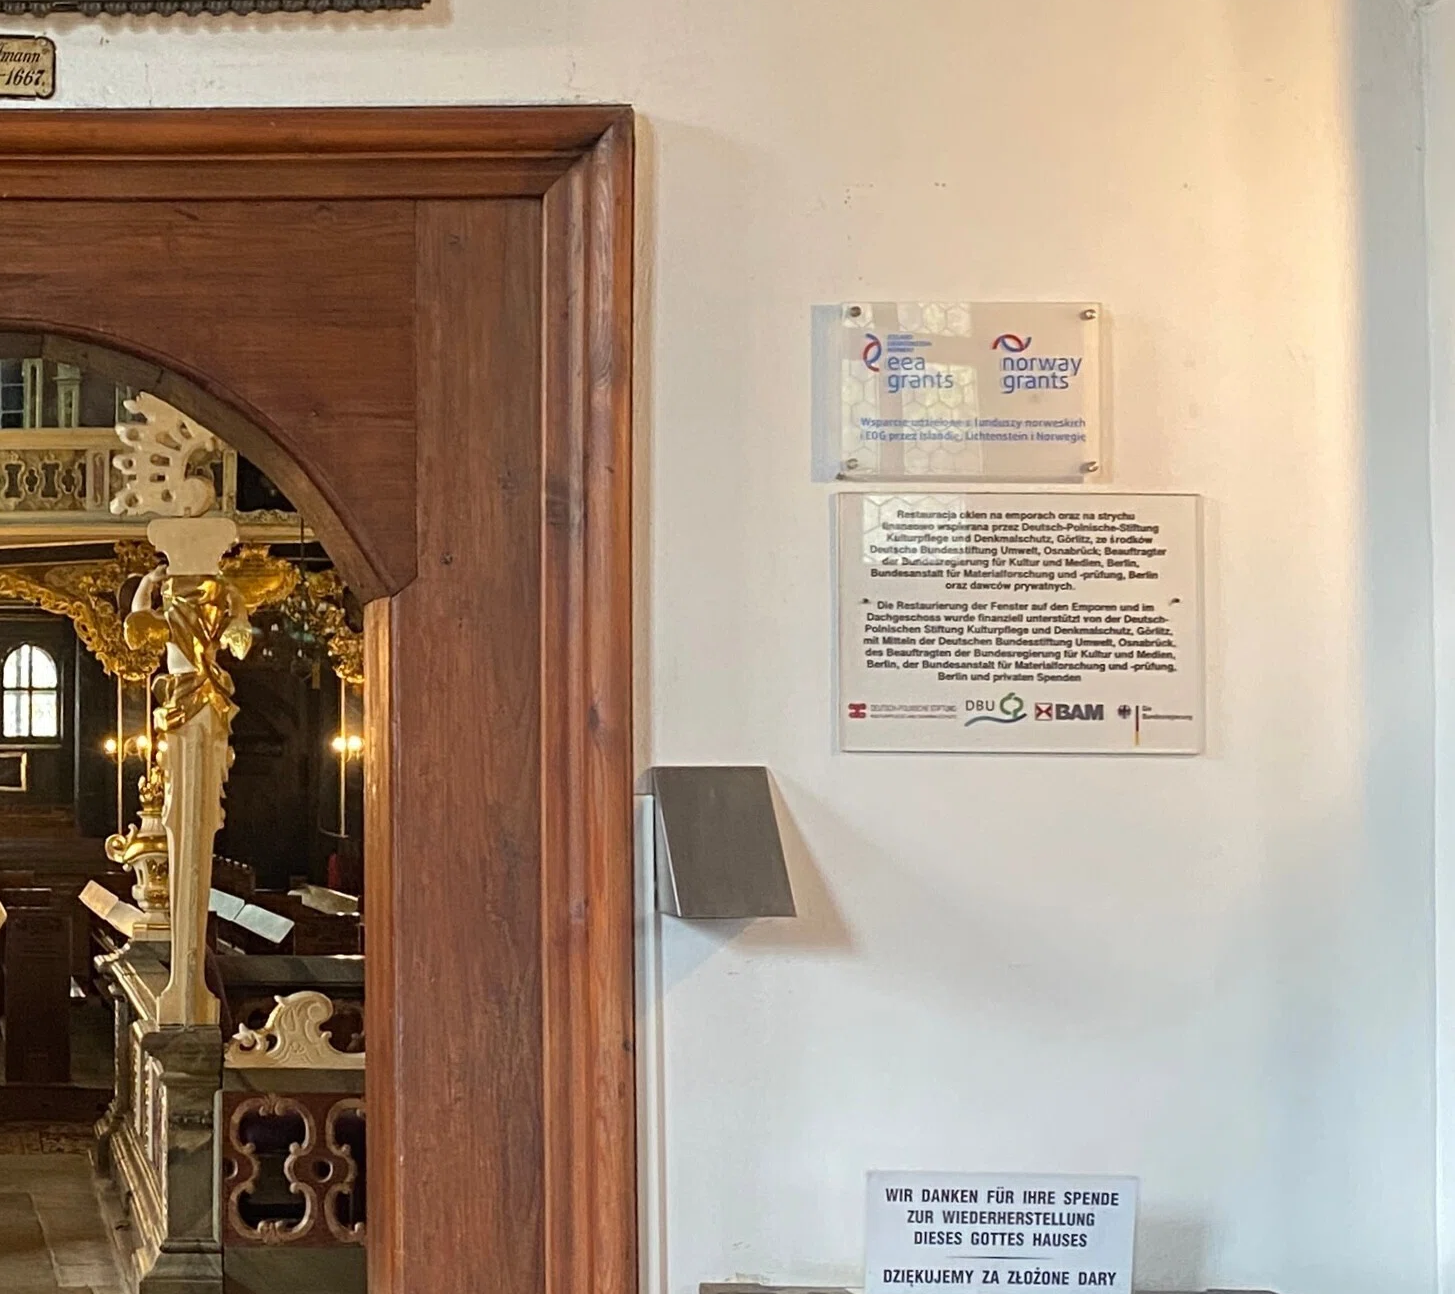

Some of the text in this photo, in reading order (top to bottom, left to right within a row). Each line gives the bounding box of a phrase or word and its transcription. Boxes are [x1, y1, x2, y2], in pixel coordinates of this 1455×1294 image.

[887, 356, 926, 371] eea
[1002, 356, 1083, 376] norway
[887, 371, 954, 394] grants
[1002, 373, 1069, 394] grants
[1024, 418, 1086, 428] norweskich
[865, 431, 886, 441] EOG
[888, 432, 917, 442] przez
[965, 432, 1028, 442] Lichtenstein
[896, 509, 1136, 523] Restauracja okien na emporach oraz na strychu
[991, 523, 1020, 533] przez
[1021, 522, 1160, 535] Deutsch-Polnische-Stiftung
[886, 534, 949, 545] Kulturpflege
[951, 534, 972, 543] und
[973, 534, 1055, 545] Denkmalschutz,
[1056, 534, 1094, 545] Görlitz,
[1109, 535, 1154, 545] środków
[869, 545, 918, 555] Deutsche
[920, 545, 998, 557] Bundesstiftung
[1000, 546, 1042, 557] Umwelt,
[1104, 546, 1168, 558] Beauftragter
[881, 557, 1140, 569] der Bundesregierung für Kultur und Medien, Berlin,
[870, 569, 944, 578] Bundesanstalt
[946, 569, 961, 578] für
[963, 569, 1055, 581] Materialforschung
[1057, 571, 1077, 579] und
[1128, 570, 1159, 580] Berlin
[944, 582, 968, 590] oraz
[969, 581, 1012, 591] dawców
[876, 600, 1155, 614] Die Restaurierung der Fenster auf den Emporen und im
[866, 612, 1170, 624] Dachgeschoss wurde finanziell unterstützt von der Deutsch-
[864, 624, 922, 634] Polnischen
[923, 624, 964, 636] Stiftung
[966, 624, 1030, 636] Kulturpflege
[1031, 625, 1052, 635] und
[1053, 625, 1135, 637] Denkmalschutz,
[863, 636, 880, 646] mit
[882, 636, 917, 646] Mitteln
[918, 637, 936, 646] der
[937, 637, 993, 647] Deutschen
[864, 648, 884, 658] des
[886, 648, 952, 659] Beauftragten
[954, 648, 972, 658] der
[973, 648, 1062, 661] Bundesregierung
[1063, 649, 1078, 659] für
[1080, 649, 1113, 659] Kultur
[1114, 650, 1135, 659] und
[866, 659, 901, 670] Berlin,
[902, 660, 920, 670] der
[921, 660, 996, 671] Bundesanstalt
[997, 660, 1012, 670] für
[1014, 660, 1106, 673] Materialforschung
[1108, 661, 1129, 671] und
[937, 671, 1082, 684] Berlin und privaten Spenden
[964, 699, 996, 712] DBU
[1055, 703, 1105, 721] BAM
[885, 1186, 1120, 1207] WIR DANKEN FÜR IHRE SPENDE
[906, 1209, 1096, 1227] ZUR WIEDERHERSTELLUNG
[913, 1231, 1088, 1248] DIESES GOTTES HAUSES
[882, 1266, 1117, 1288] DZIĘKUJEMY ZA ZŁOŻONE DARY
